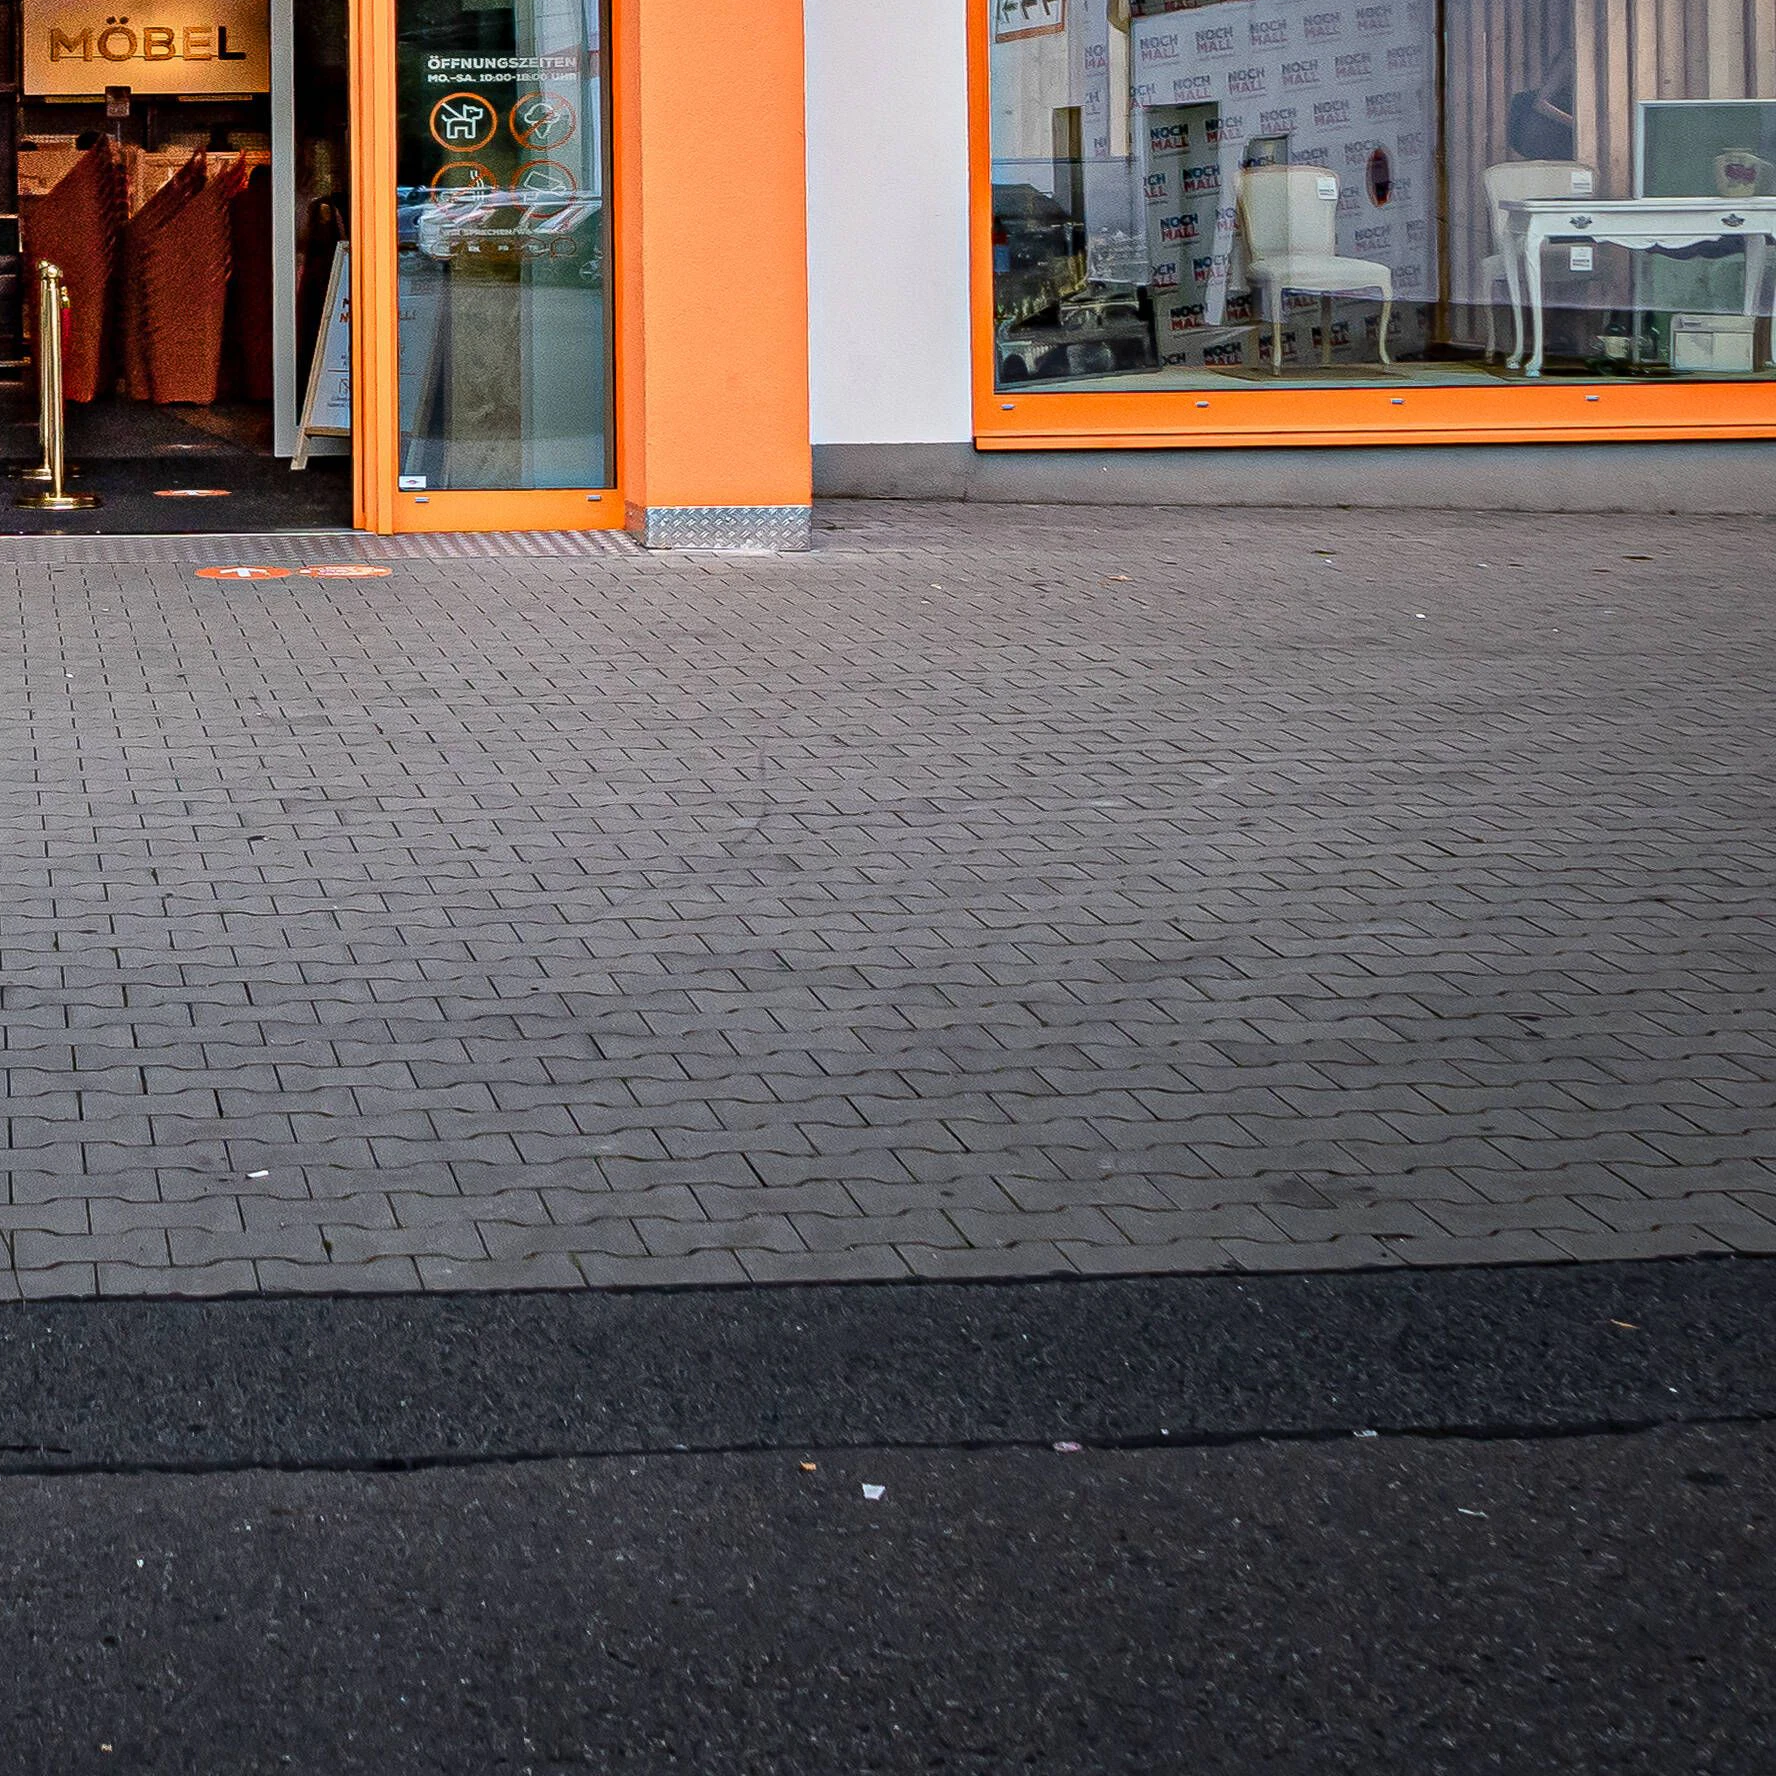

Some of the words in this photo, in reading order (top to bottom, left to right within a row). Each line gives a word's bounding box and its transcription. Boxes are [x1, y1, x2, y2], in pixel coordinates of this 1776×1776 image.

[1195, 27, 1234, 42] NOCH
[1249, 20, 1287, 35] NOCH
[50, 16, 246, 62] MÖBEL
[1140, 34, 1178, 50] NOCH
[1196, 39, 1234, 54] MALL
[1251, 32, 1288, 46] MALL
[1141, 47, 1179, 62] MALL
[427, 55, 576, 70] ÖFFNUNGSZEITEN
[1281, 59, 1319, 74] NOCH
[427, 73, 476, 83] MO.-SA.
[1173, 75, 1211, 90] NOCH
[1228, 68, 1265, 83] NOCH
[1282, 72, 1321, 86] MALL
[1130, 83, 1156, 97] OCH
[1175, 88, 1212, 102] MALL
[1229, 80, 1266, 95] MALL
[1205, 116, 1242, 131] NOCH
[1150, 124, 1189, 140] NOCH
[1206, 129, 1243, 143] MALL
[1152, 137, 1189, 152] MALL
[1183, 164, 1220, 180] NOCH
[1184, 178, 1221, 192] MALL
[1160, 213, 1198, 229] NOCH
[1161, 226, 1199, 241] MALL
[1226, 294, 1252, 308] NOC
[1203, 341, 1241, 357] NOCH
